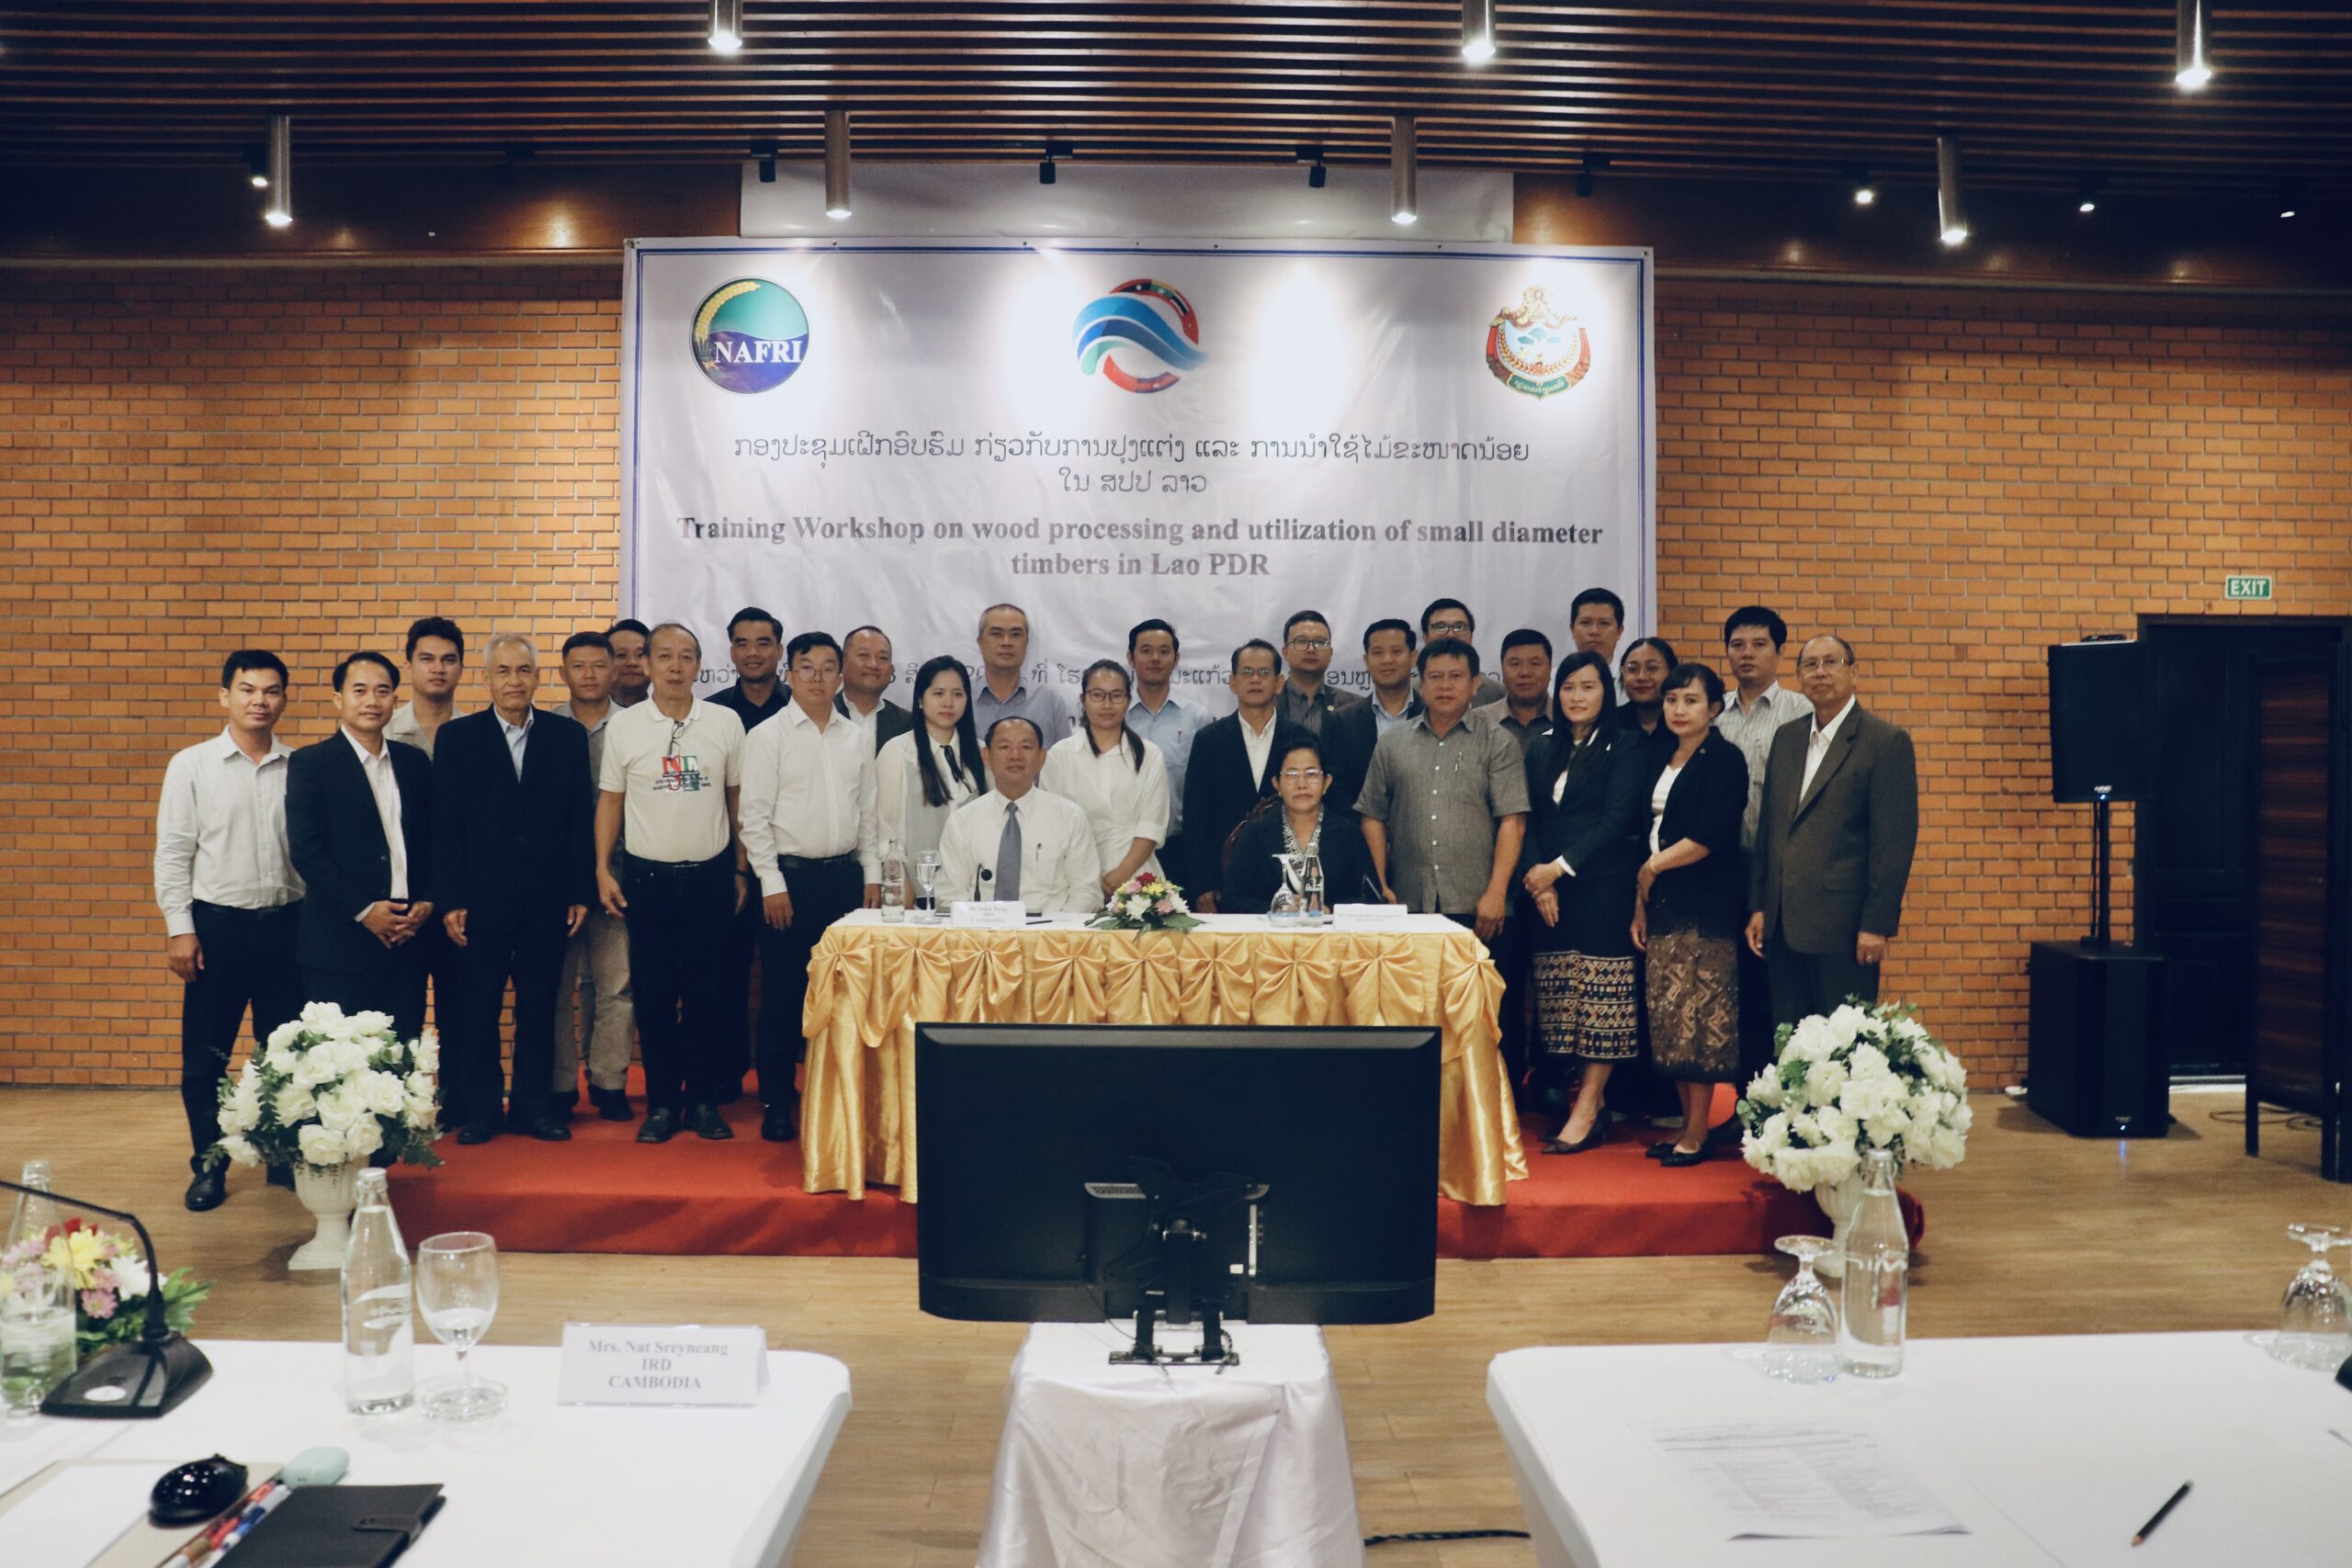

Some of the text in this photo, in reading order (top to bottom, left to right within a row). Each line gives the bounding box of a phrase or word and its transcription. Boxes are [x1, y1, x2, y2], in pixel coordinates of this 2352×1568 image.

[714, 340, 803, 364] NAFRI
[1194, 440, 1240, 458] ແລະ
[1058, 466, 1207, 493] ໃນ ສປປ ລາວ
[677, 516, 1603, 547] Training Workshop on wood processing and utilization of small diameter
[1012, 553, 1270, 577] timbers in Lao PDR
[2231, 580, 2266, 596] EXIT
[589, 1340, 729, 1357] Mrs. Nat Sreyneang
[641, 1358, 673, 1371] IRD
[608, 1375, 702, 1390] CAMBODIA
